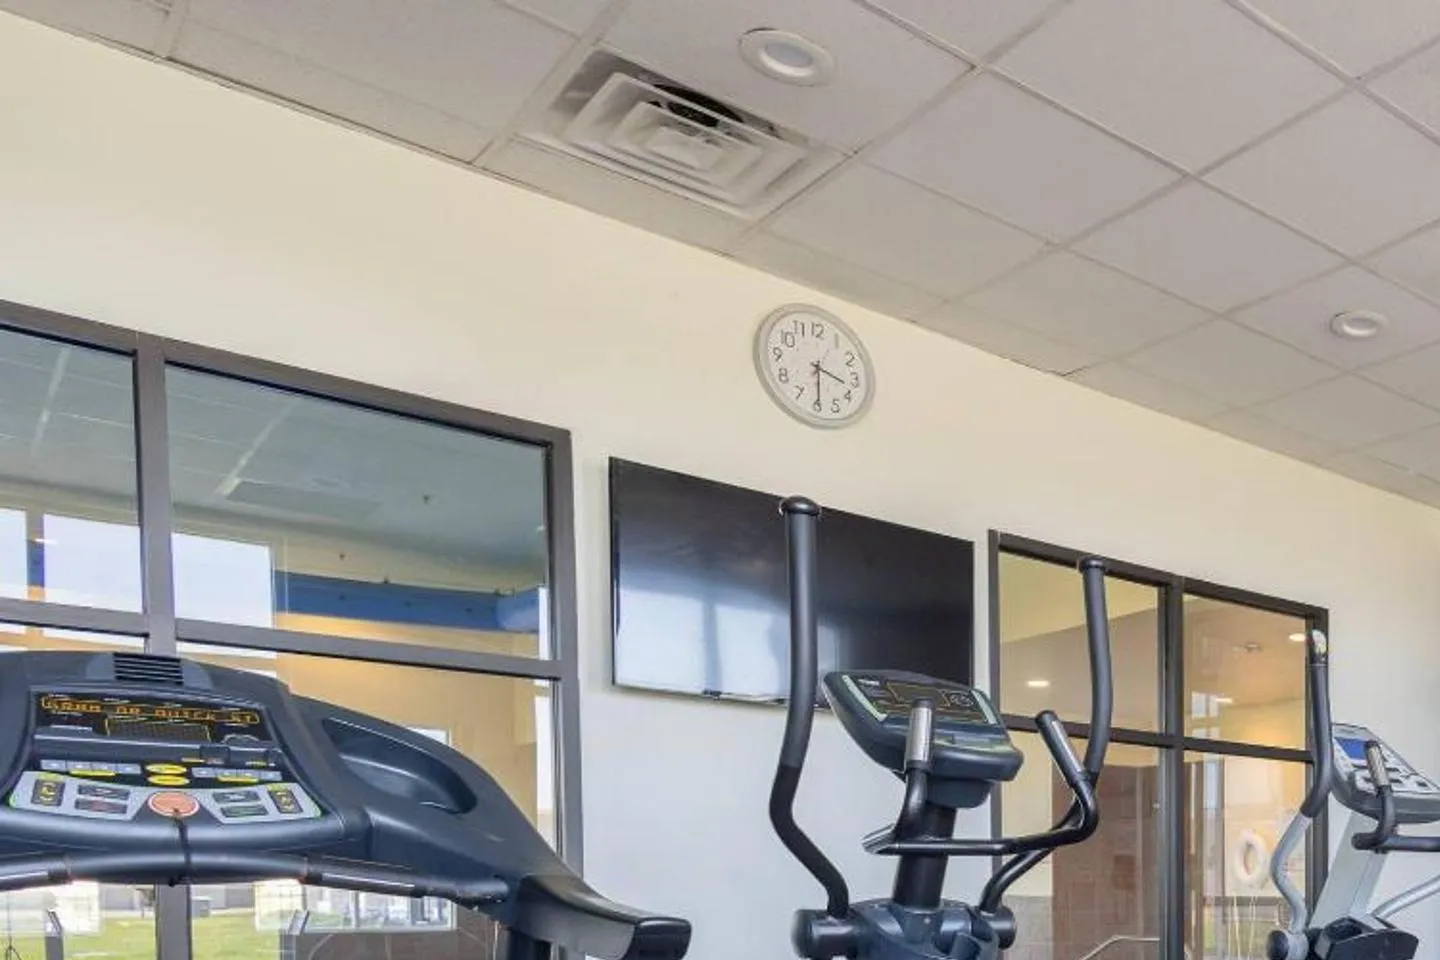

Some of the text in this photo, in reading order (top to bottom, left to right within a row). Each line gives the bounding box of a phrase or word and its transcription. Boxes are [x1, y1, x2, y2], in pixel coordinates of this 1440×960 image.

[780, 329, 795, 348] 10
[811, 321, 824, 340] 12
[772, 346, 783, 361] 9
[845, 350, 855, 367] 2
[778, 367, 789, 384] 8
[794, 384, 805, 400] 7
[843, 389, 852, 403] 4
[830, 398, 841, 413] 5
